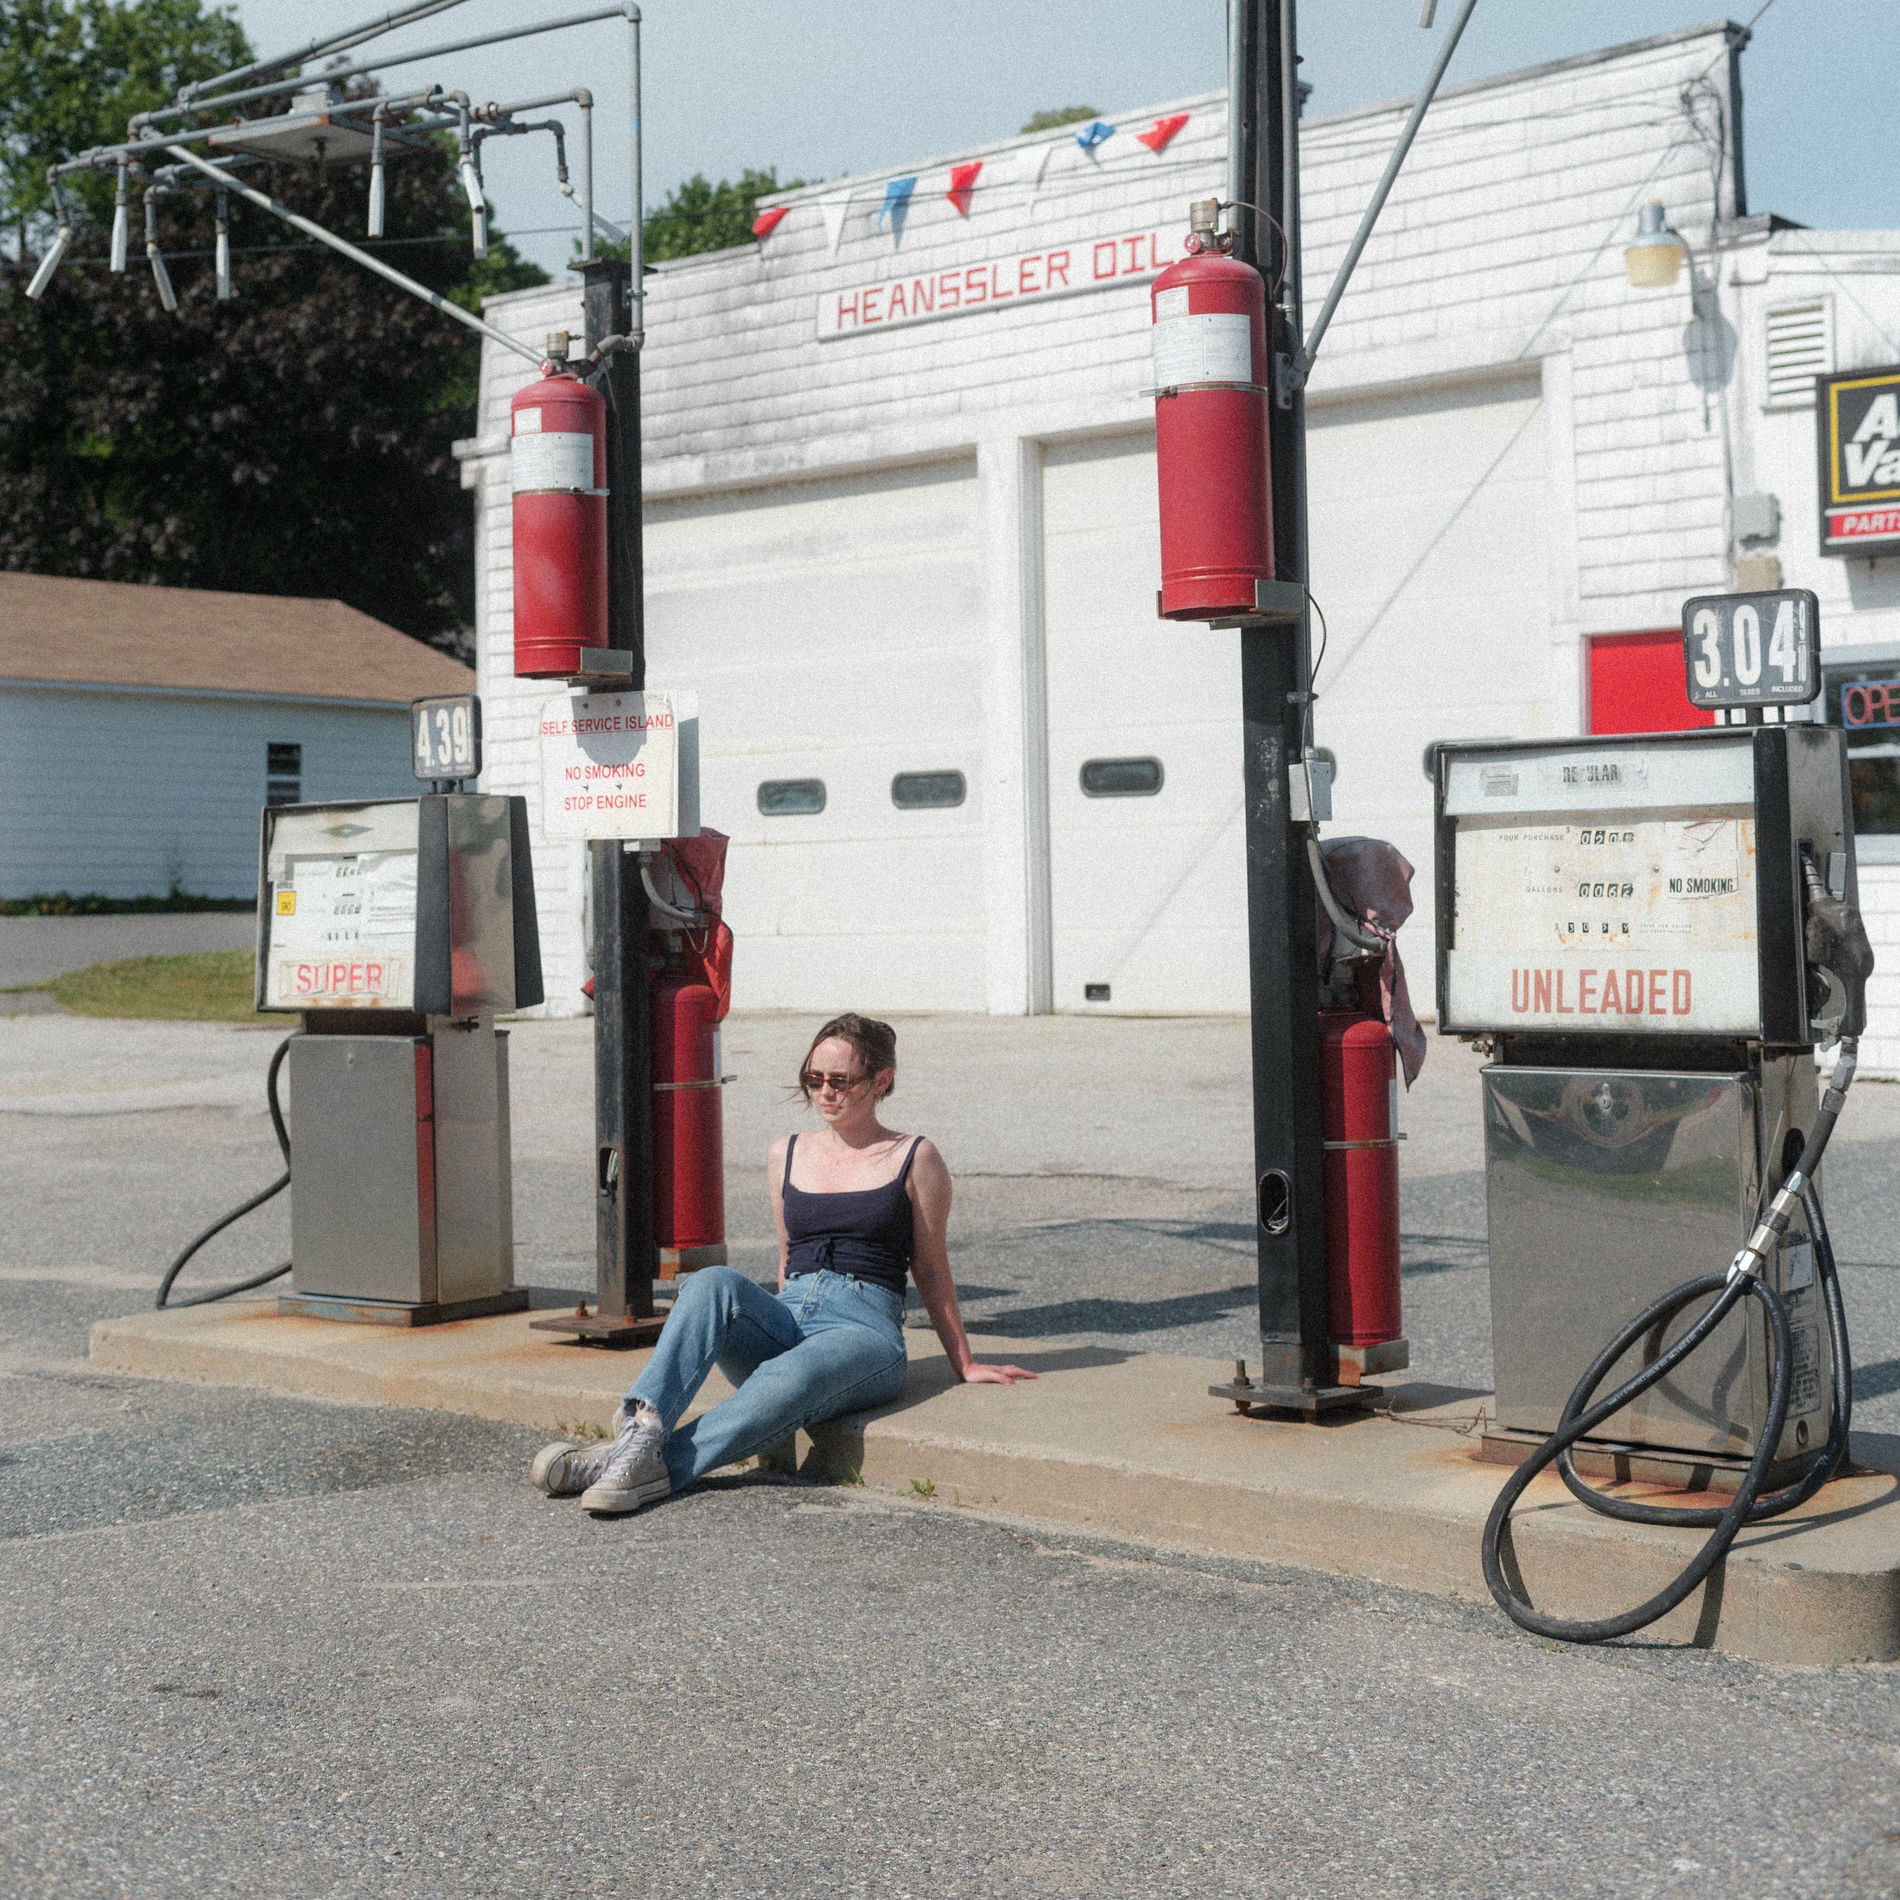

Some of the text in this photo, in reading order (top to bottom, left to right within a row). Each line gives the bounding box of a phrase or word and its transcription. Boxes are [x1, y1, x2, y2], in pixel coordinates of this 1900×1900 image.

[837, 233, 1174, 329] HEANSSLER OIL
[1693, 600, 1797, 688] 3.04
[1739, 688, 1760, 696] TAXES
[1771, 685, 1804, 693] INCLUDED
[542, 713, 674, 735] SELF SERVICE ISLAND
[565, 763, 646, 780] NO SMOKING
[1562, 764, 1618, 783] REULAR
[564, 794, 647, 811] STOP ENGINE
[1499, 833, 1519, 841] YOUR
[1523, 831, 1565, 841] PURCHASE
[1669, 878, 1734, 894] NO SMOKING
[297, 962, 383, 994] SUPER
[1511, 969, 1692, 1016] UNLEADED
